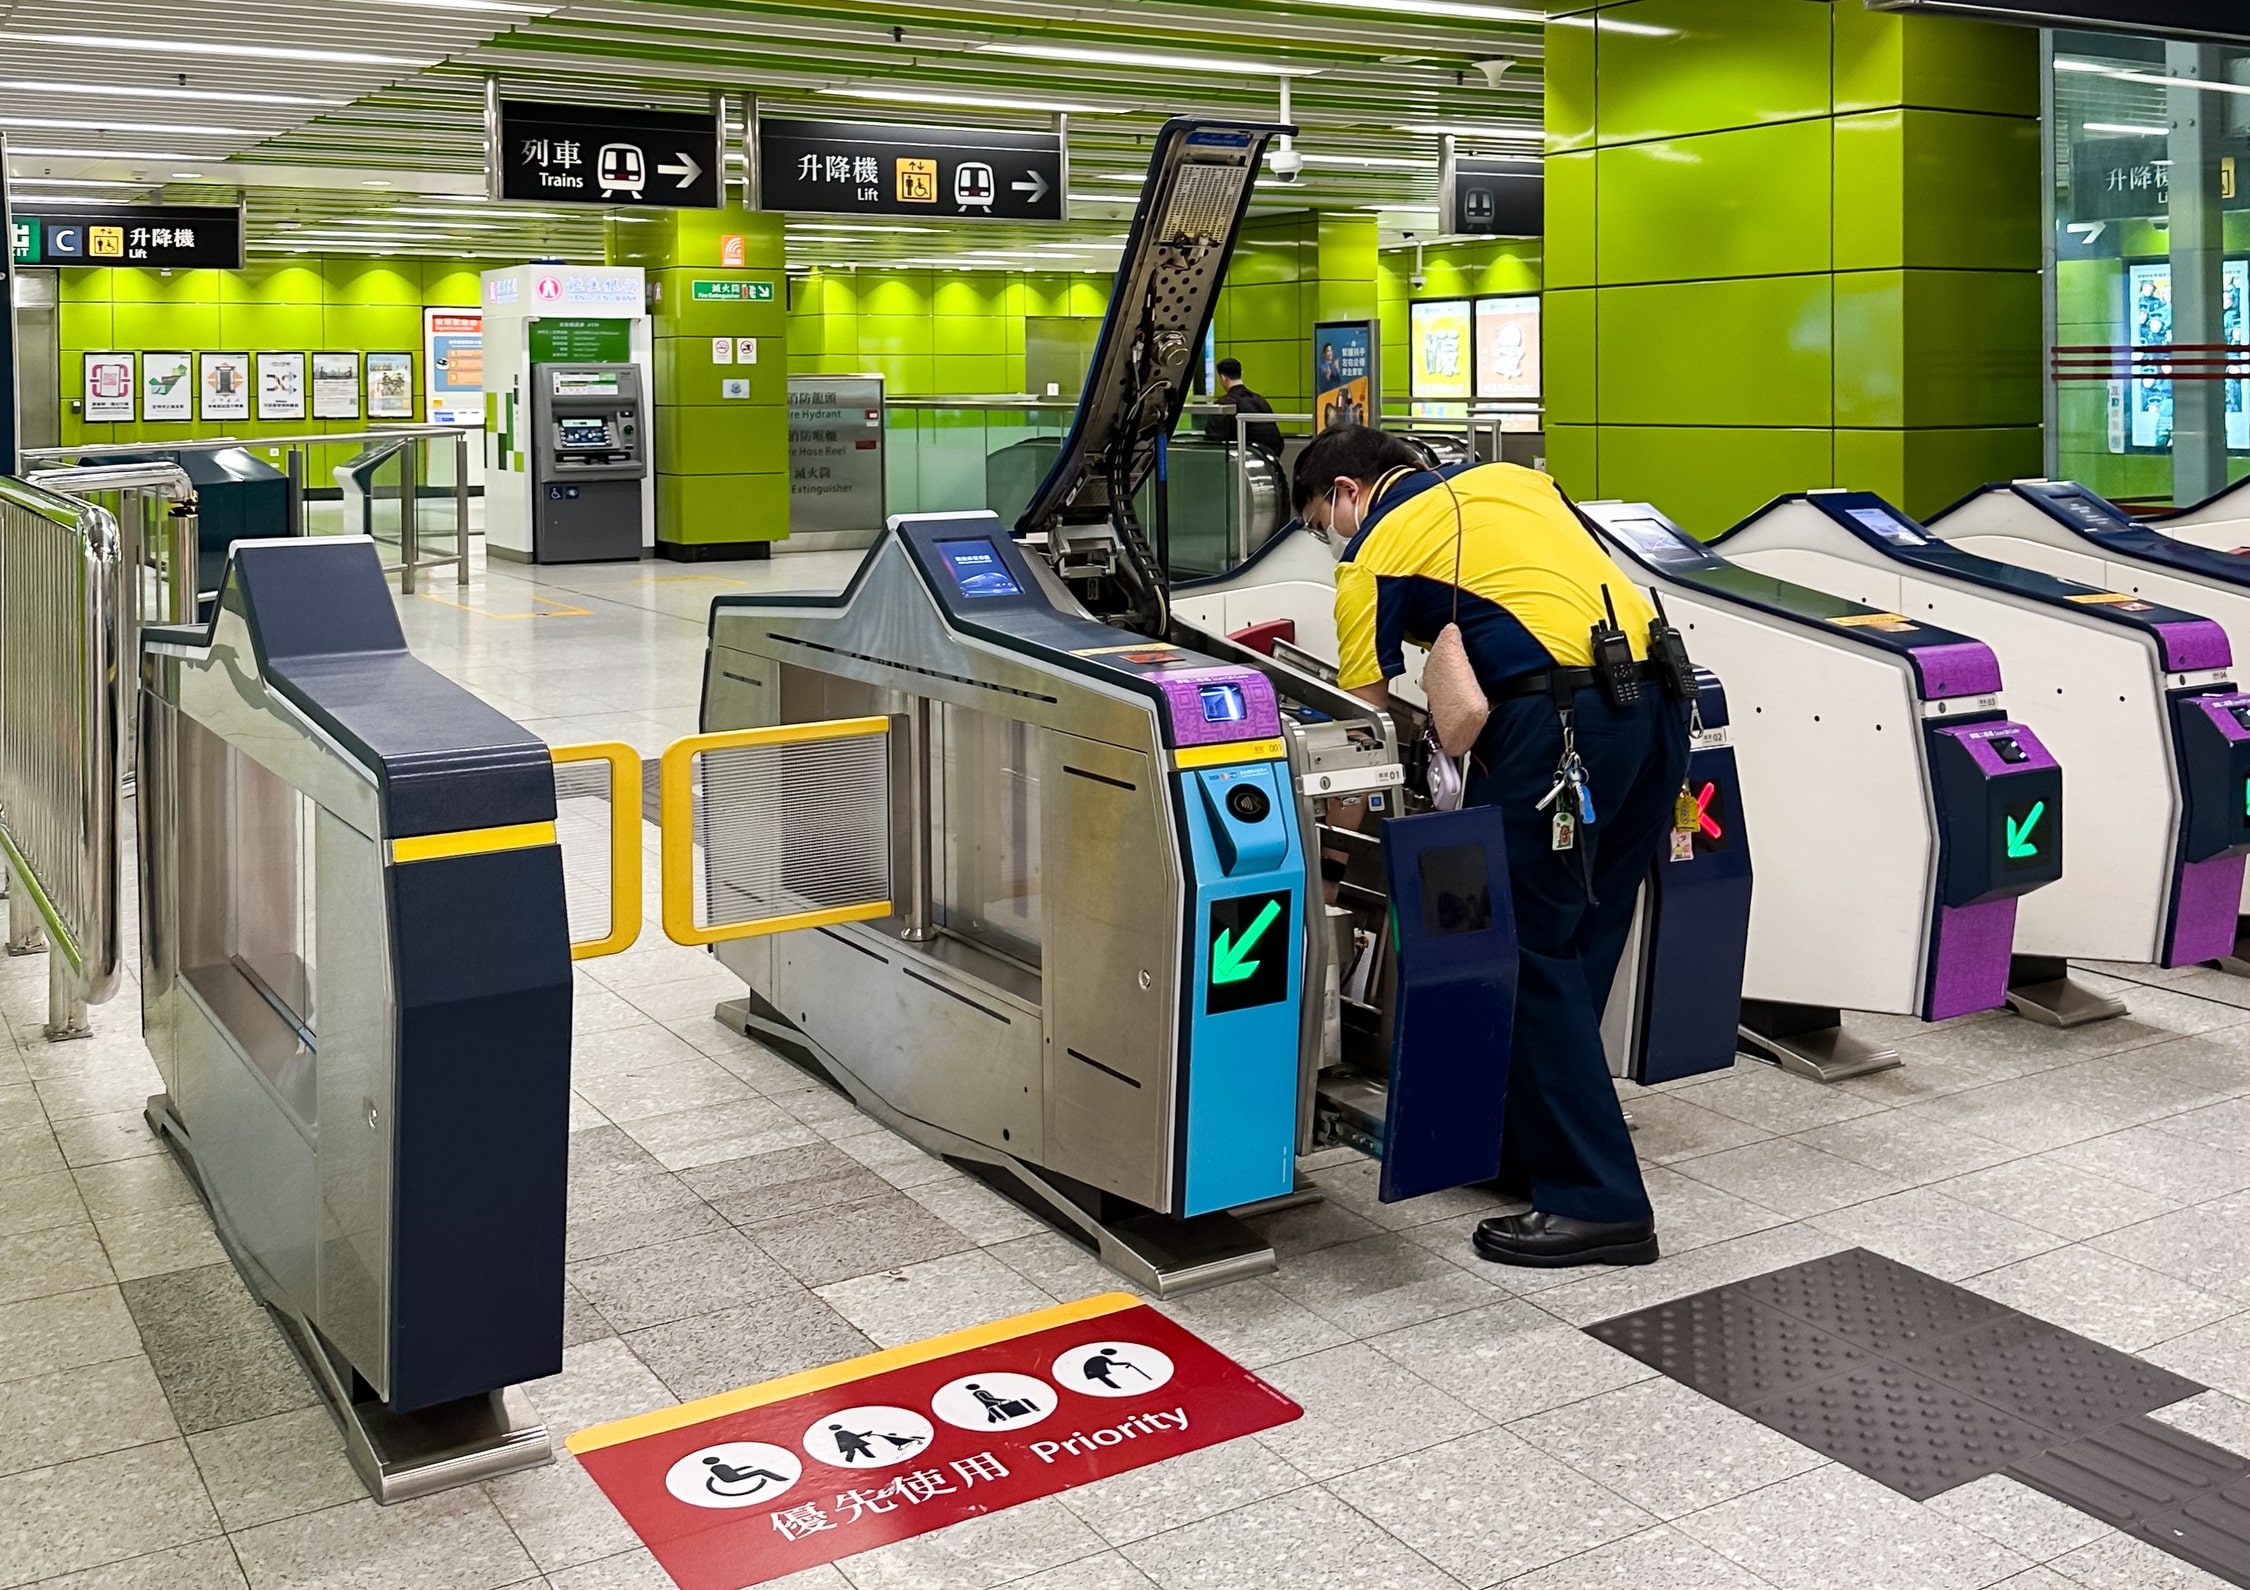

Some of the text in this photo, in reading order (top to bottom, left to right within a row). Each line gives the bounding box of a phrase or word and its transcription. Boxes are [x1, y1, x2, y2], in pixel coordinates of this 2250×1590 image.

[520, 138, 583, 169] 列車
[797, 154, 880, 184] 升降機
[538, 171, 584, 188] Trains
[857, 187, 880, 202] Lift
[55, 230, 75, 251] C
[129, 227, 195, 248] 升降機
[129, 249, 147, 259] Lift
[802, 409, 842, 421] Hydrant
[799, 446, 825, 457] Hose
[825, 445, 847, 456] Reel
[791, 484, 853, 496] Extinguisher
[1713, 733, 1722, 742] 02
[1389, 770, 1400, 780] 01
[771, 1407, 1190, 1542] 優先使用 Priority
